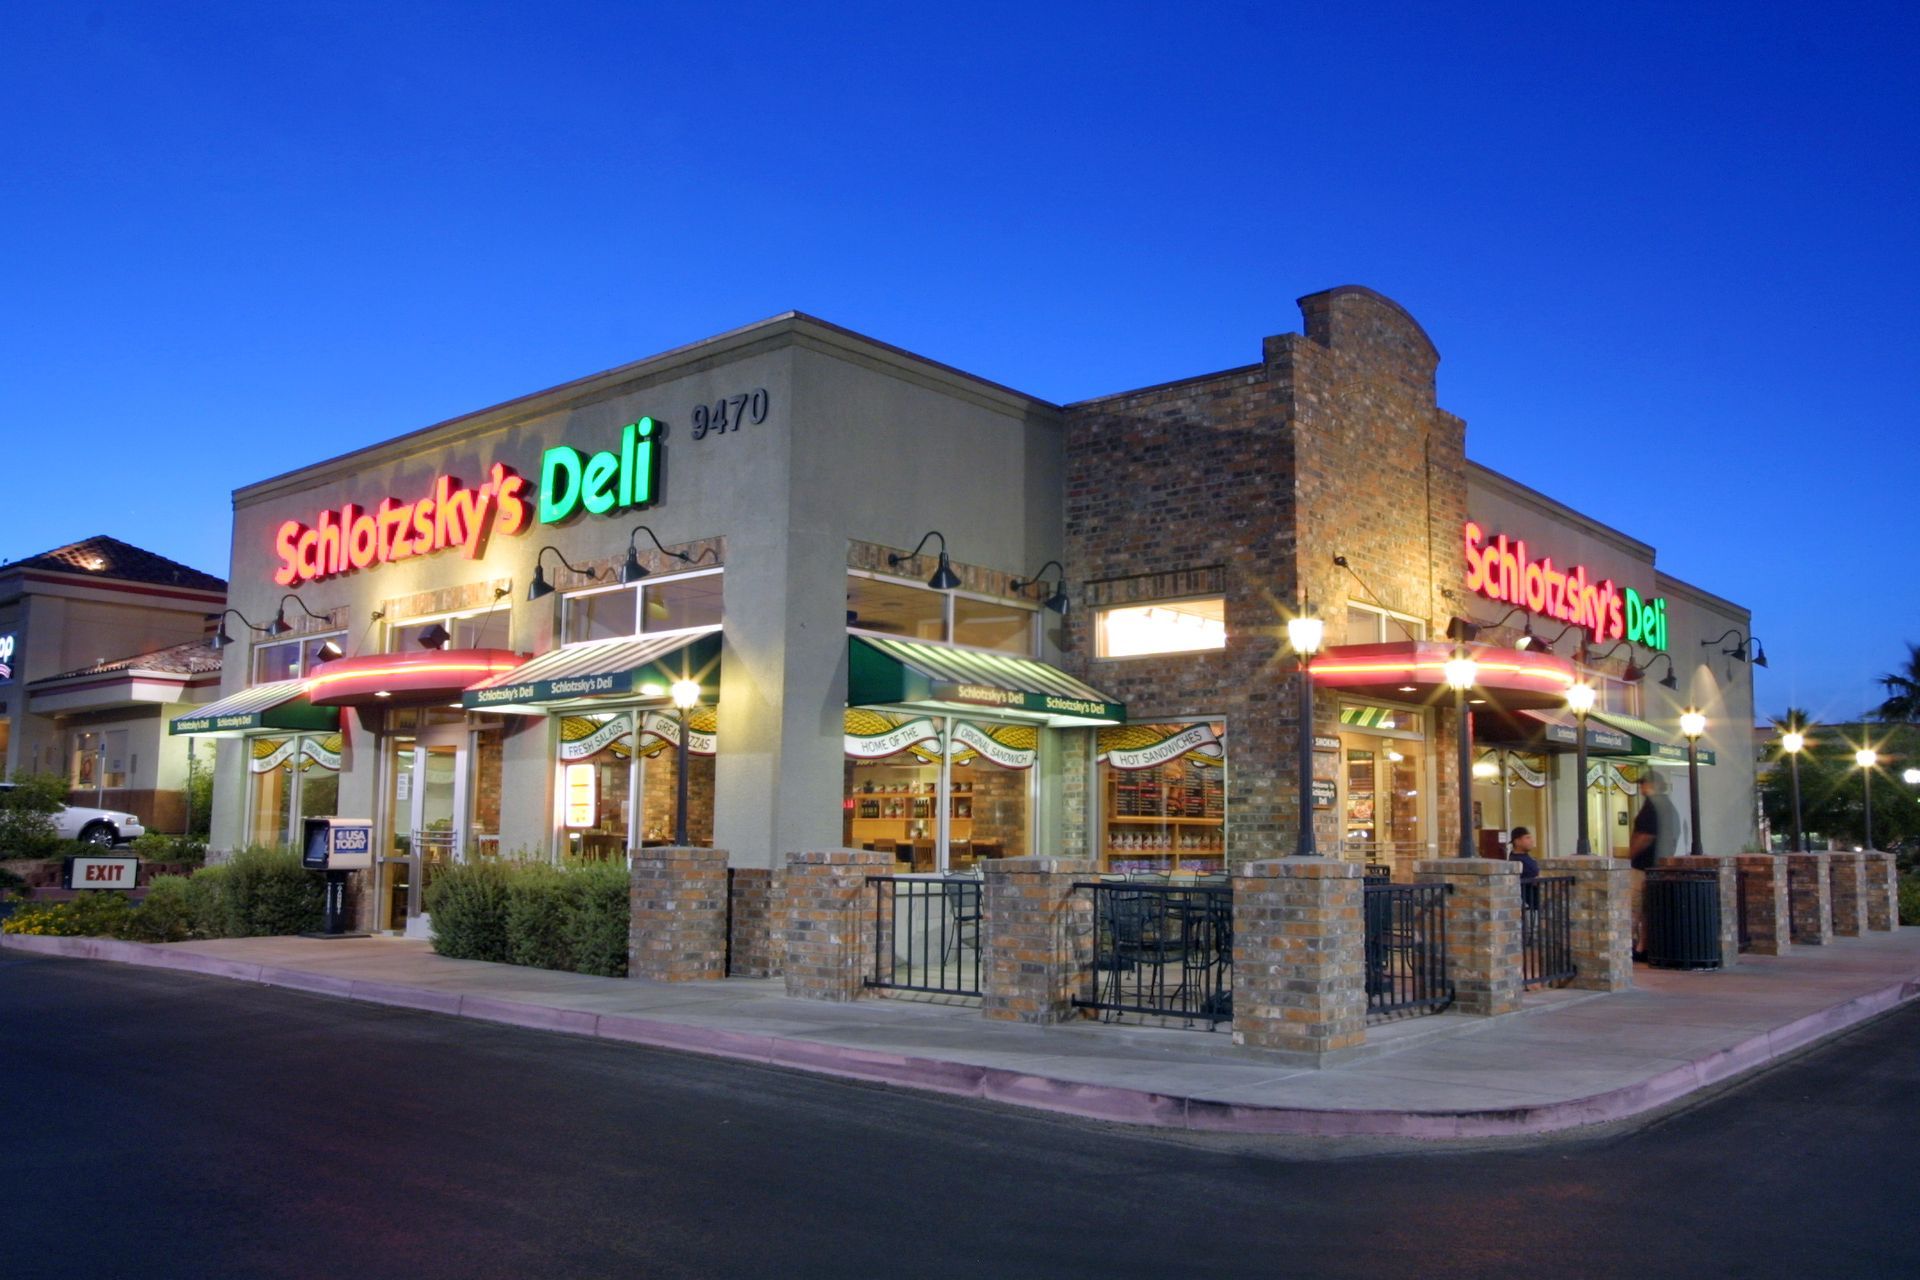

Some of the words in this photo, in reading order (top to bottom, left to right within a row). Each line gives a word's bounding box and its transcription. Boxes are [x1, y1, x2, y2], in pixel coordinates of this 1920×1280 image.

[691, 387, 769, 441] 9470
[275, 462, 529, 587] Schlotzsky's
[539, 415, 663, 525] Deli
[1465, 521, 1624, 644] Schlotzsky's
[1625, 587, 1667, 650] Deli
[478, 688, 518, 702] Schlotzsky's
[519, 685, 534, 697] Deli
[551, 679, 595, 694] Schlotzsky's
[596, 676, 613, 689] Deli
[958, 686, 1006, 703] Schlotzsky's
[1007, 690, 1025, 704] Deli
[1046, 697, 1090, 715] Schlotzsky's
[1090, 703, 1105, 715] Deli
[568, 741, 594, 757] FRESH
[594, 721, 624, 747] SALADS
[861, 740, 888, 752] HOME
[889, 736, 901, 747] OF
[903, 727, 919, 742] THE
[961, 728, 989, 753] ORIGINAL
[991, 747, 1028, 764] SANDWICH
[1119, 755, 1139, 766] HOT
[1141, 730, 1202, 763] SANDWICHES
[336, 840, 366, 850] TODAY
[345, 832, 364, 842] USA
[86, 865, 125, 881] EXIT
